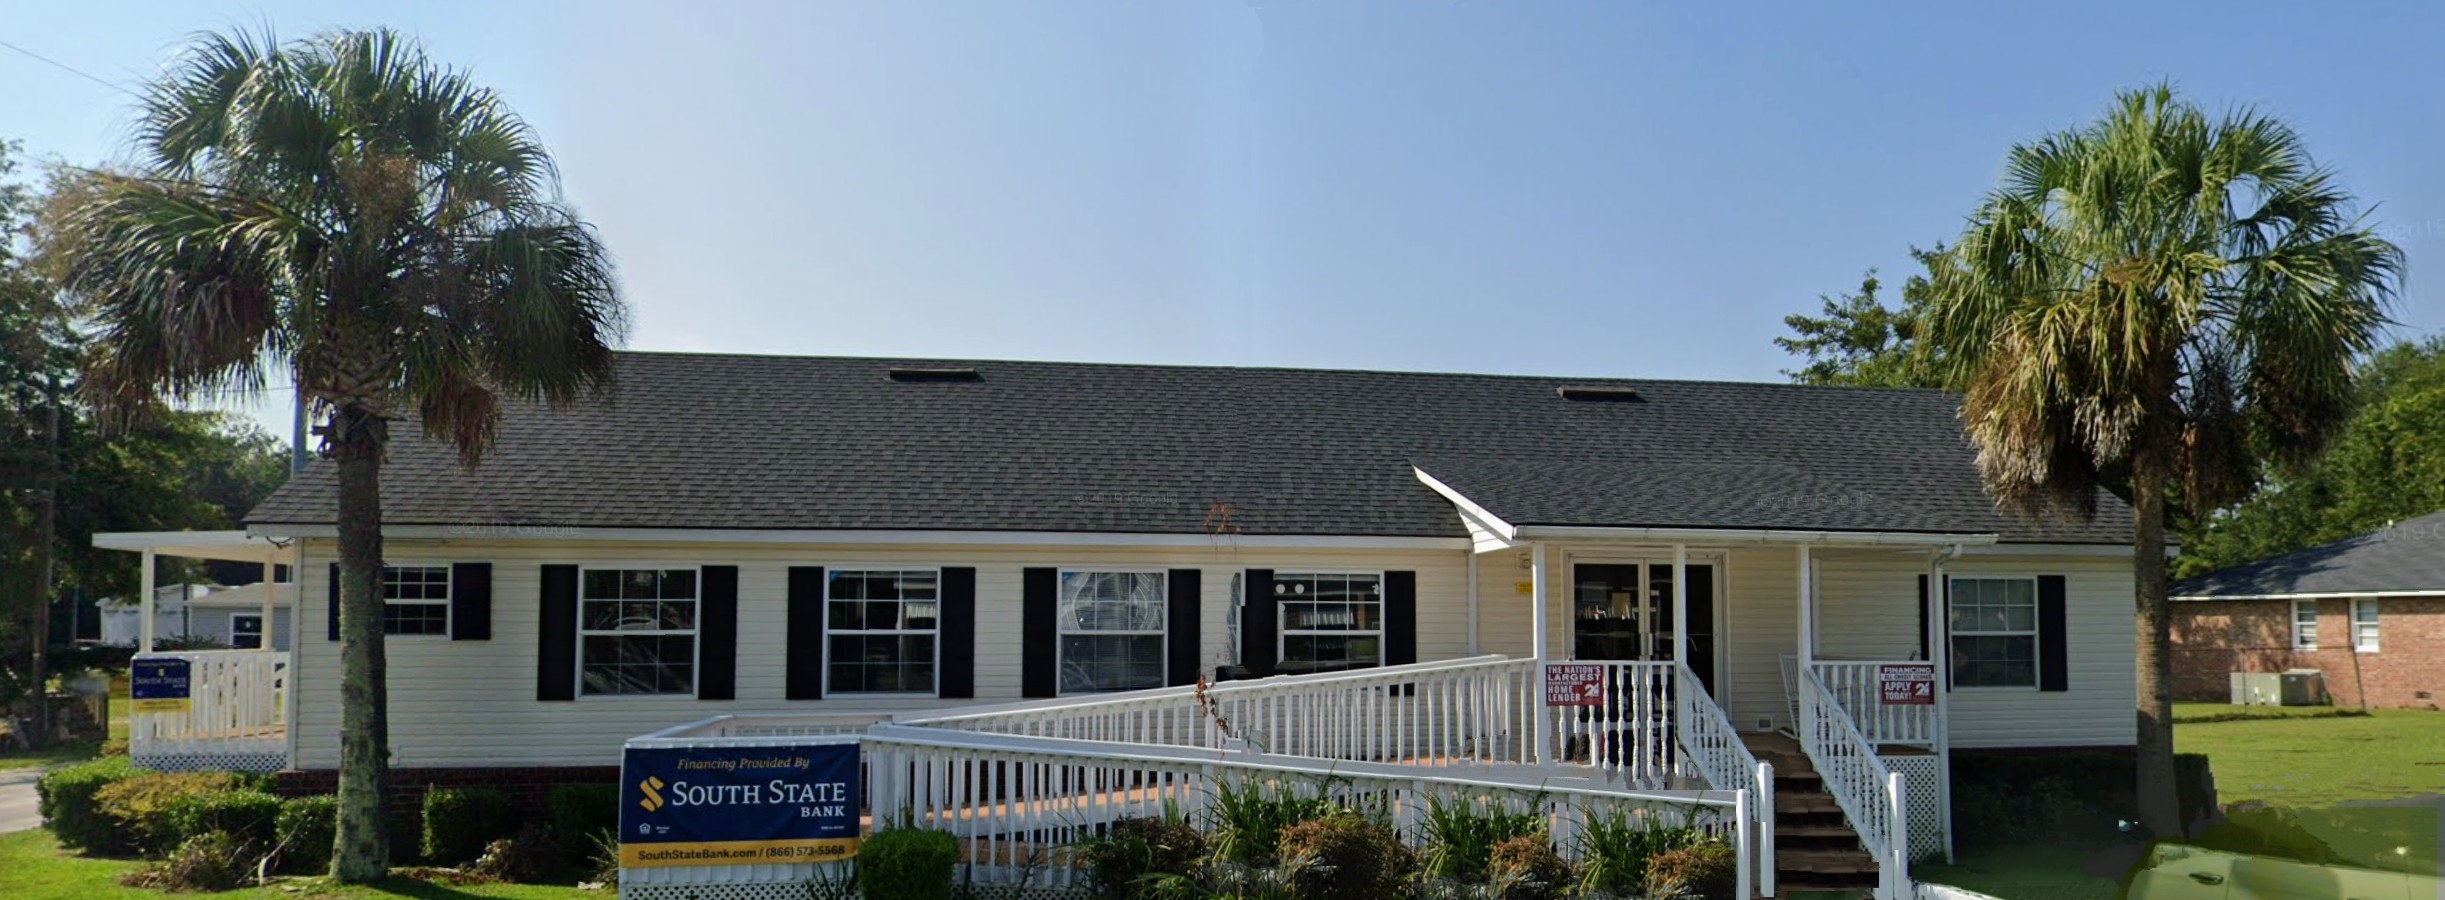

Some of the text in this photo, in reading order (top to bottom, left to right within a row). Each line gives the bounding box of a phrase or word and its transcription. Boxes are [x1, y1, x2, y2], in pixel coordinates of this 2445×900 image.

[1548, 665, 1601, 674] THE NATION'S
[1884, 666, 1932, 675] FINANCING
[1548, 673, 1601, 682] LARGEST
[1548, 685, 1574, 694] HOME
[1885, 681, 1912, 691] APPLY
[1548, 693, 1581, 702] LENDER
[1885, 691, 1912, 700] TODAY!
[677, 756, 810, 771] Financing Provided By
[672, 779, 847, 806] SOUTH STATE
[801, 805, 846, 818] BANK
[638, 848, 757, 861] SouthStateBank.com
[765, 846, 794, 859] (866)
[796, 844, 846, 857] 573-5568
